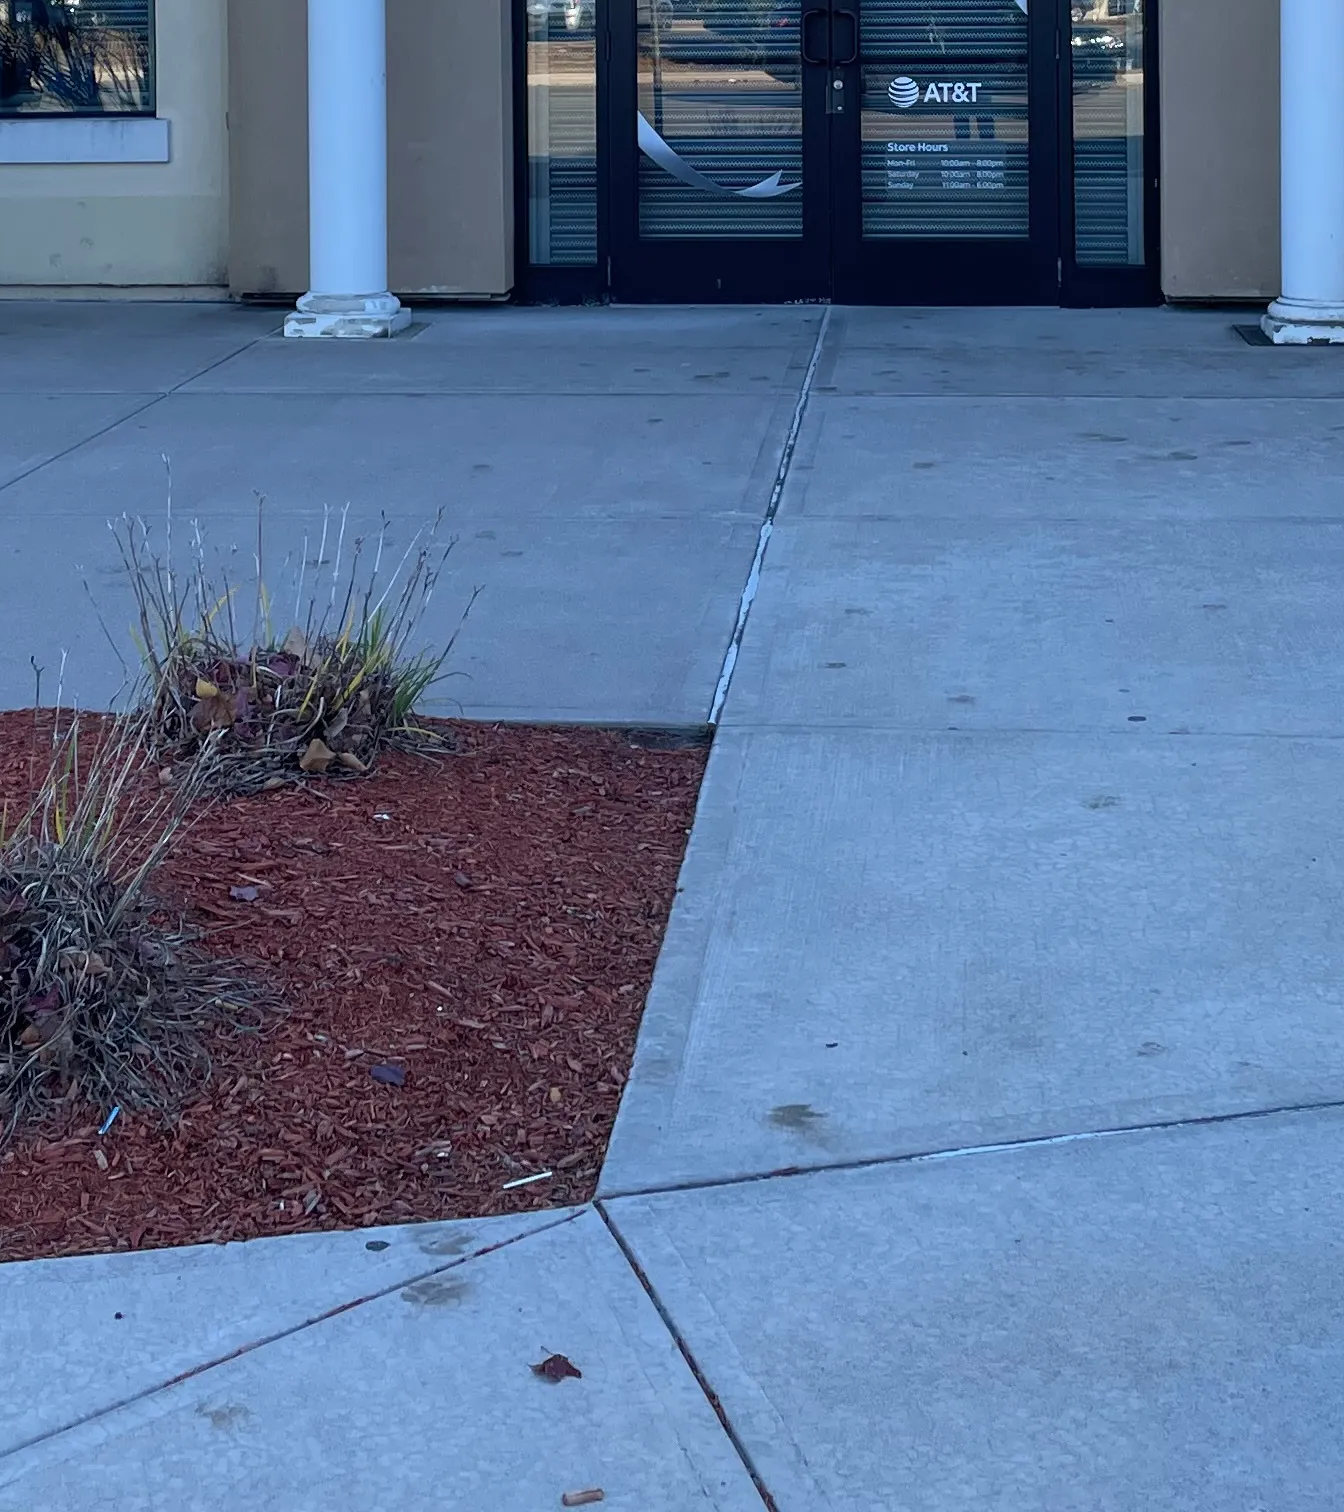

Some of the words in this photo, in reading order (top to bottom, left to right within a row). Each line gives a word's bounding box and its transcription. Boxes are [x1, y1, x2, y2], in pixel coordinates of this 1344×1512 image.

[923, 82, 982, 103] AT&T
[887, 142, 916, 152] Store
[917, 142, 949, 152] Hours
